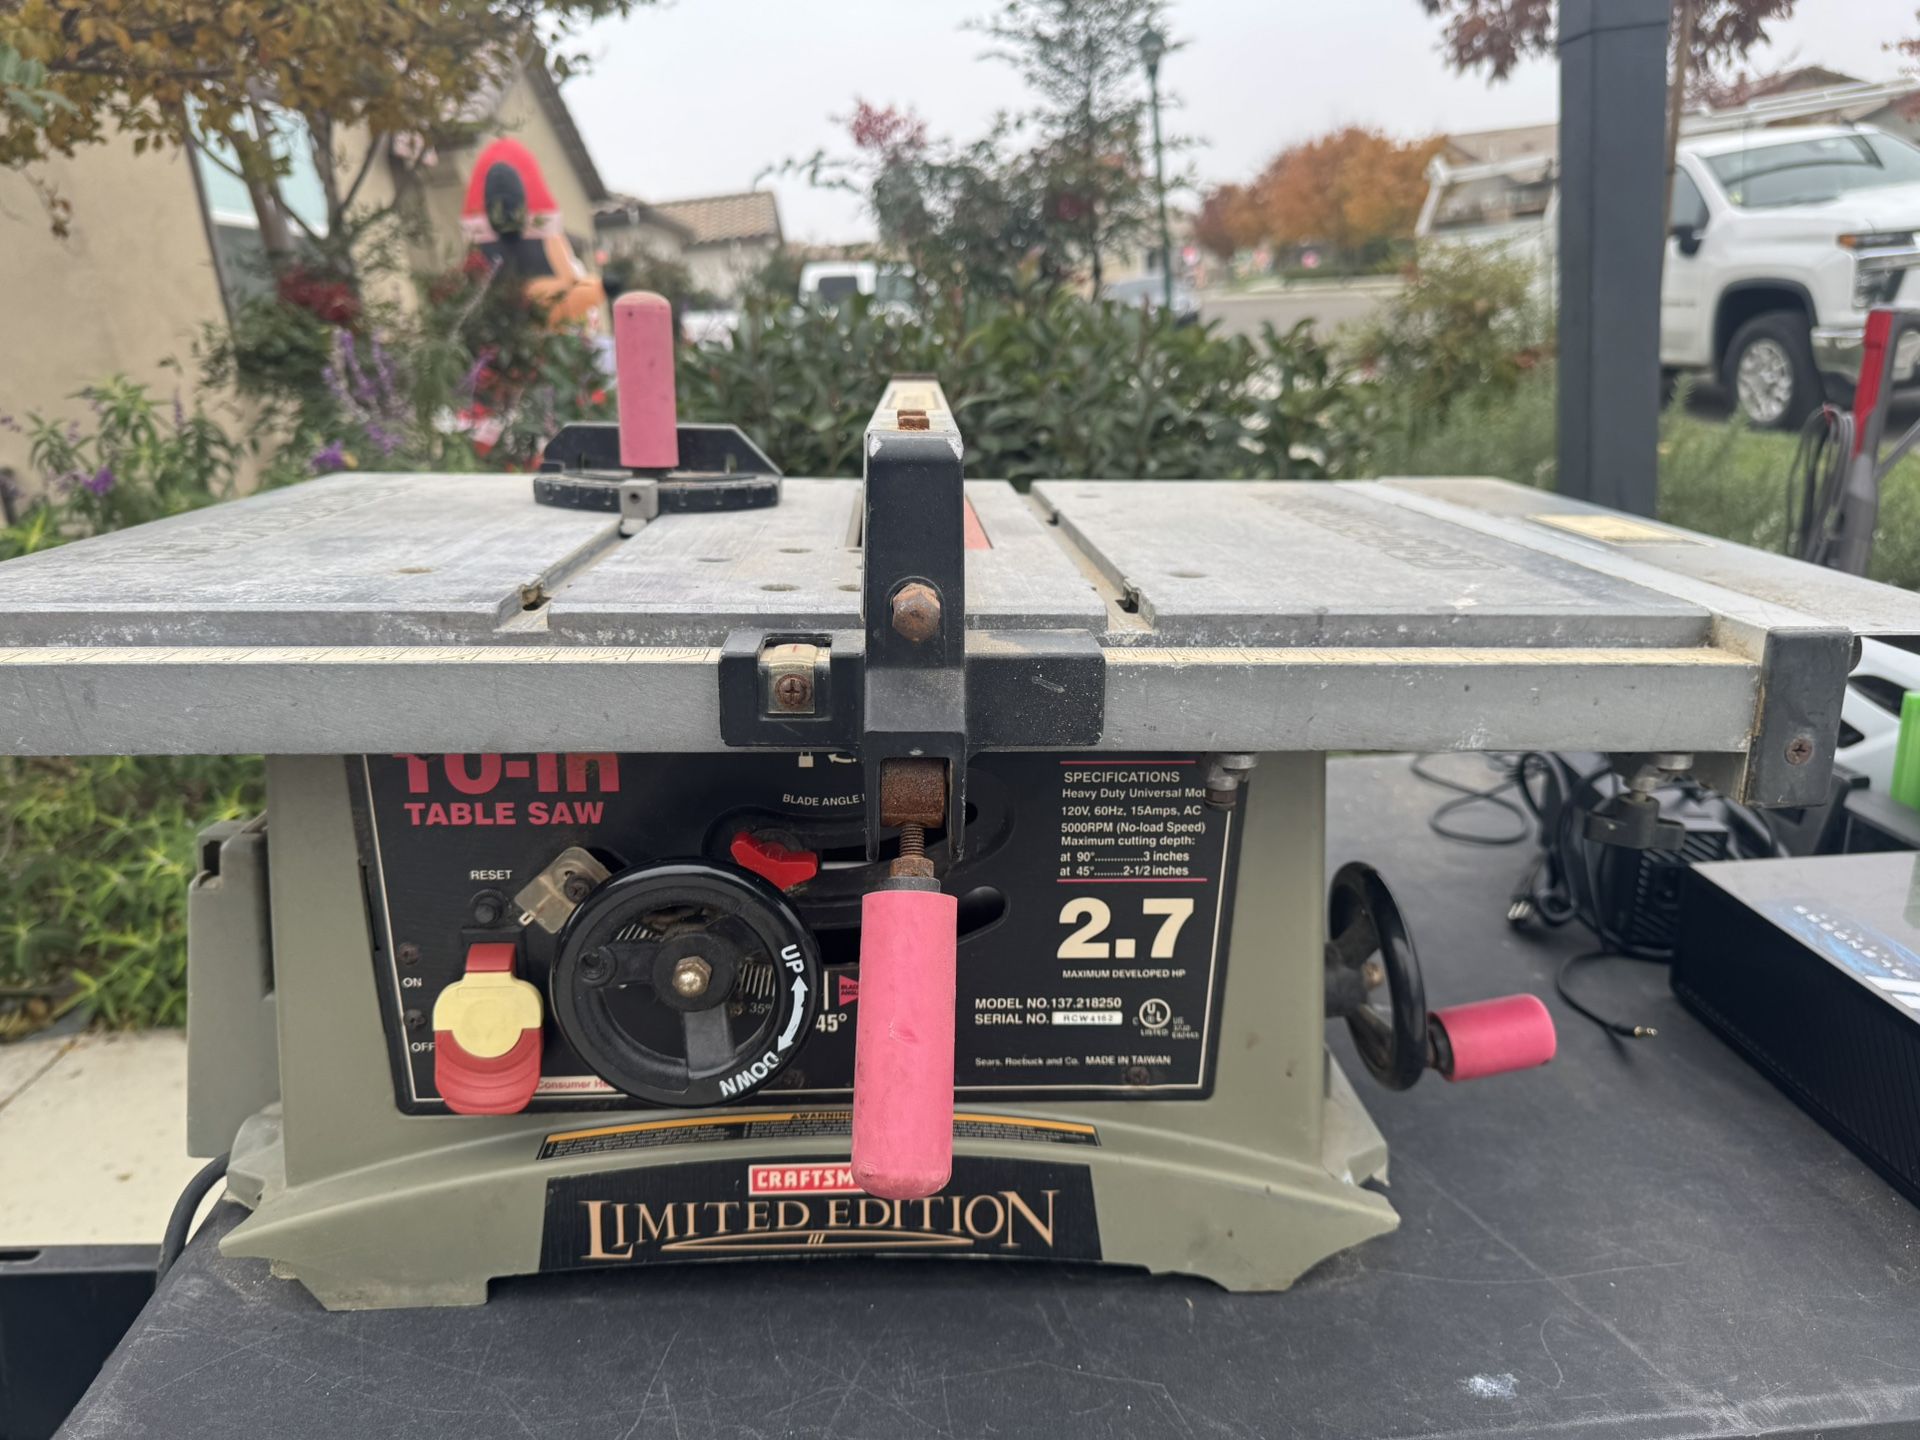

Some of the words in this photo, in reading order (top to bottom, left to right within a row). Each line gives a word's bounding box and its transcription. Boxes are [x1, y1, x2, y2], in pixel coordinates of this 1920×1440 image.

[1064, 771, 1180, 783] SPECIFICATIONS
[782, 793, 819, 806] BLADE
[822, 795, 861, 806] ANGLE
[1062, 788, 1097, 800] Heavy
[1100, 788, 1126, 800] Duty
[1129, 788, 1181, 798] Universal
[1184, 788, 1206, 798] Mot
[404, 802, 516, 825] TABLE
[528, 802, 604, 825] SAW
[1062, 806, 1091, 817] 120V,
[1094, 806, 1127, 816] 60Hz,
[1131, 806, 1180, 818] 15Amps,
[1183, 805, 1202, 815] AC
[1061, 823, 1113, 833] 5000RPM
[1116, 822, 1164, 834] (No-load
[1166, 821, 1206, 834] Speed)
[1061, 836, 1114, 846] Maximum
[1118, 836, 1156, 847] cutting
[1159, 836, 1195, 847] depth:
[1060, 852, 1071, 862] at
[1153, 851, 1189, 861] inches
[470, 870, 512, 879] RESET
[1060, 866, 1070, 876] at
[1152, 865, 1189, 875] inches
[1057, 897, 1194, 959] 2.7
[781, 943, 805, 973] UP
[1062, 970, 1110, 979] MAXIMUM
[1112, 969, 1170, 978] DEVELOPED
[1171, 969, 1186, 978] HP
[402, 978, 422, 987] ON
[975, 998, 1023, 1010] MODEL
[1027, 998, 1050, 1009] NO.
[1051, 997, 1122, 1009] 137.218250
[815, 1013, 848, 1032] 45°
[975, 1013, 1023, 1025] SERIAL
[1026, 1013, 1050, 1025] NO.
[411, 1042, 435, 1052] OFF
[1045, 1057, 1062, 1065] and
[1085, 1055, 1115, 1065] MADE
[1118, 1055, 1129, 1065] IN
[1131, 1055, 1171, 1065] TAIWAN
[718, 1051, 779, 1097] DOWN
[538, 1080, 591, 1090] Consumer
[594, 1079, 609, 1088] He
[757, 1167, 853, 1188] CRAFTSM
[581, 1199, 811, 1260] LIMITED
[828, 1189, 1060, 1248] EDITION
